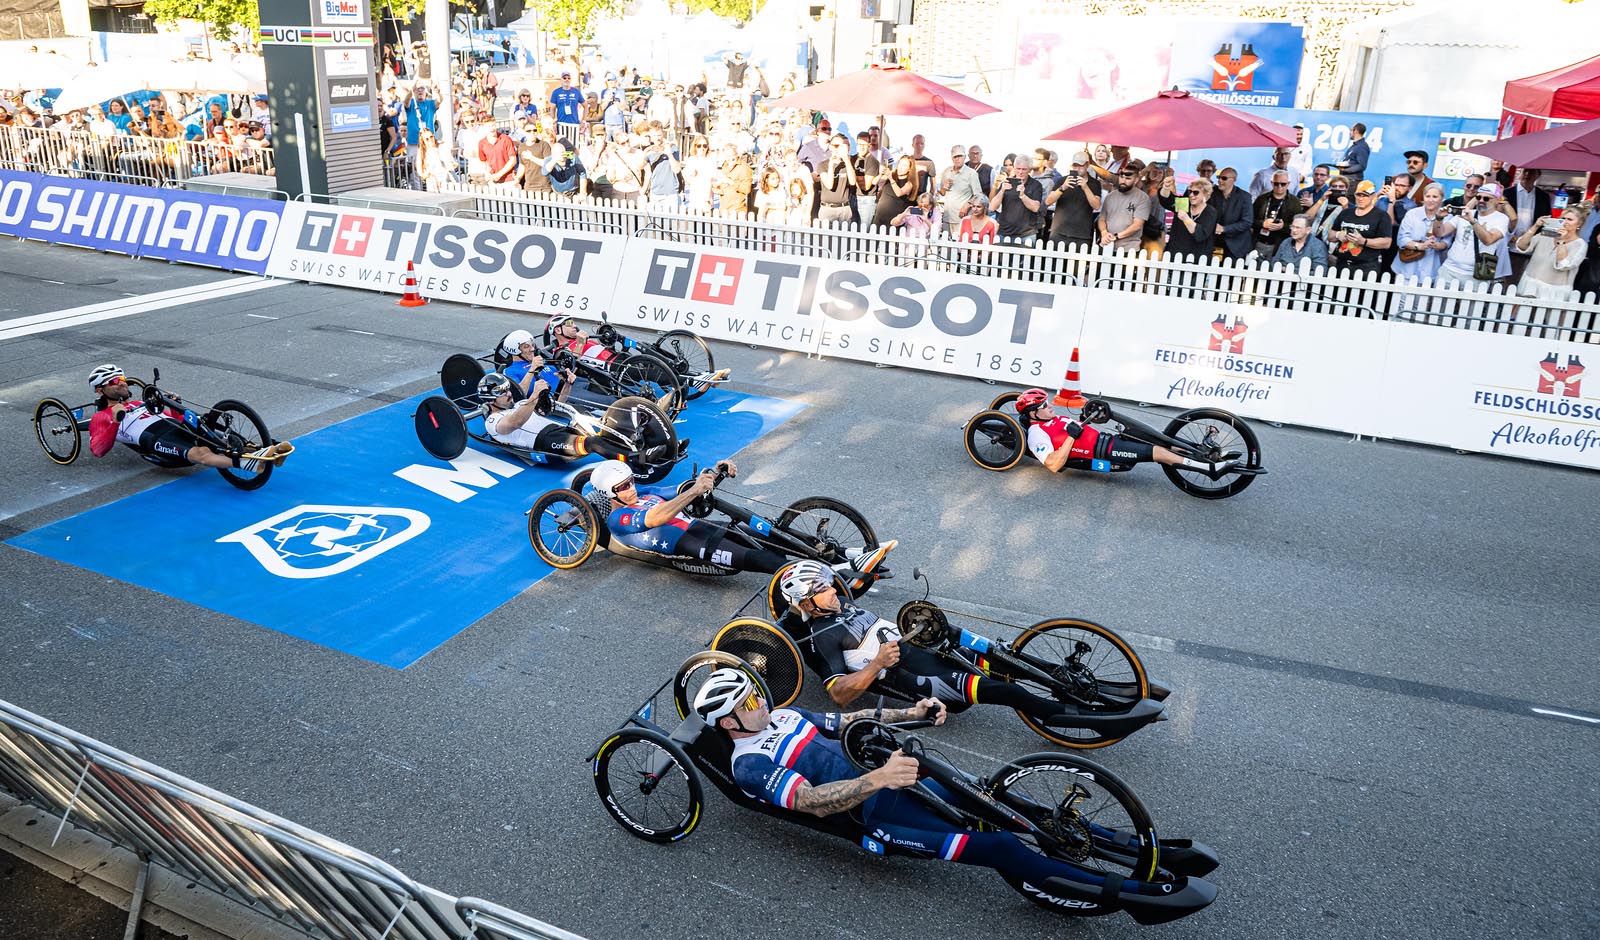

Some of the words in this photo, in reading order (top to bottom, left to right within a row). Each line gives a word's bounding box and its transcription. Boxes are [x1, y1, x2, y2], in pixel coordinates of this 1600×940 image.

[326, 1, 357, 16] BigMat
[275, 29, 299, 42] UCI
[333, 31, 356, 43] UCI
[1314, 123, 1383, 153] 204
[30, 186, 279, 262] SHIMANO
[380, 218, 602, 285] TISSOT
[289, 259, 347, 278] SWISS
[462, 282, 526, 303] SINCE
[540, 292, 590, 311] 1853
[753, 260, 1055, 344] TISSOT
[637, 305, 711, 329] SWISS
[728, 317, 850, 349] WATCHES
[868, 339, 957, 365] SINCE
[975, 352, 1042, 376] 1853
[1155, 349, 1294, 379] FELDSCHLÖSSCHEN
[1166, 377, 1272, 403] Alkoholfrei
[188, 415, 193, 423] 2
[637, 403, 671, 440] CORIMA
[154, 441, 179, 456] Canada
[551, 442, 574, 450] Cofidis
[1112, 450, 1138, 459] EVIDEN
[1098, 462, 1104, 470] 3
[756, 522, 763, 531] 6
[970, 635, 980, 646] 7
[639, 739, 690, 781] CORIMA
[765, 766, 783, 790] CORIMA
[1004, 764, 1095, 787] CORIMA
[606, 794, 656, 836] CORIMA
[868, 840, 878, 852] 8
[893, 838, 926, 849] LOURMEL
